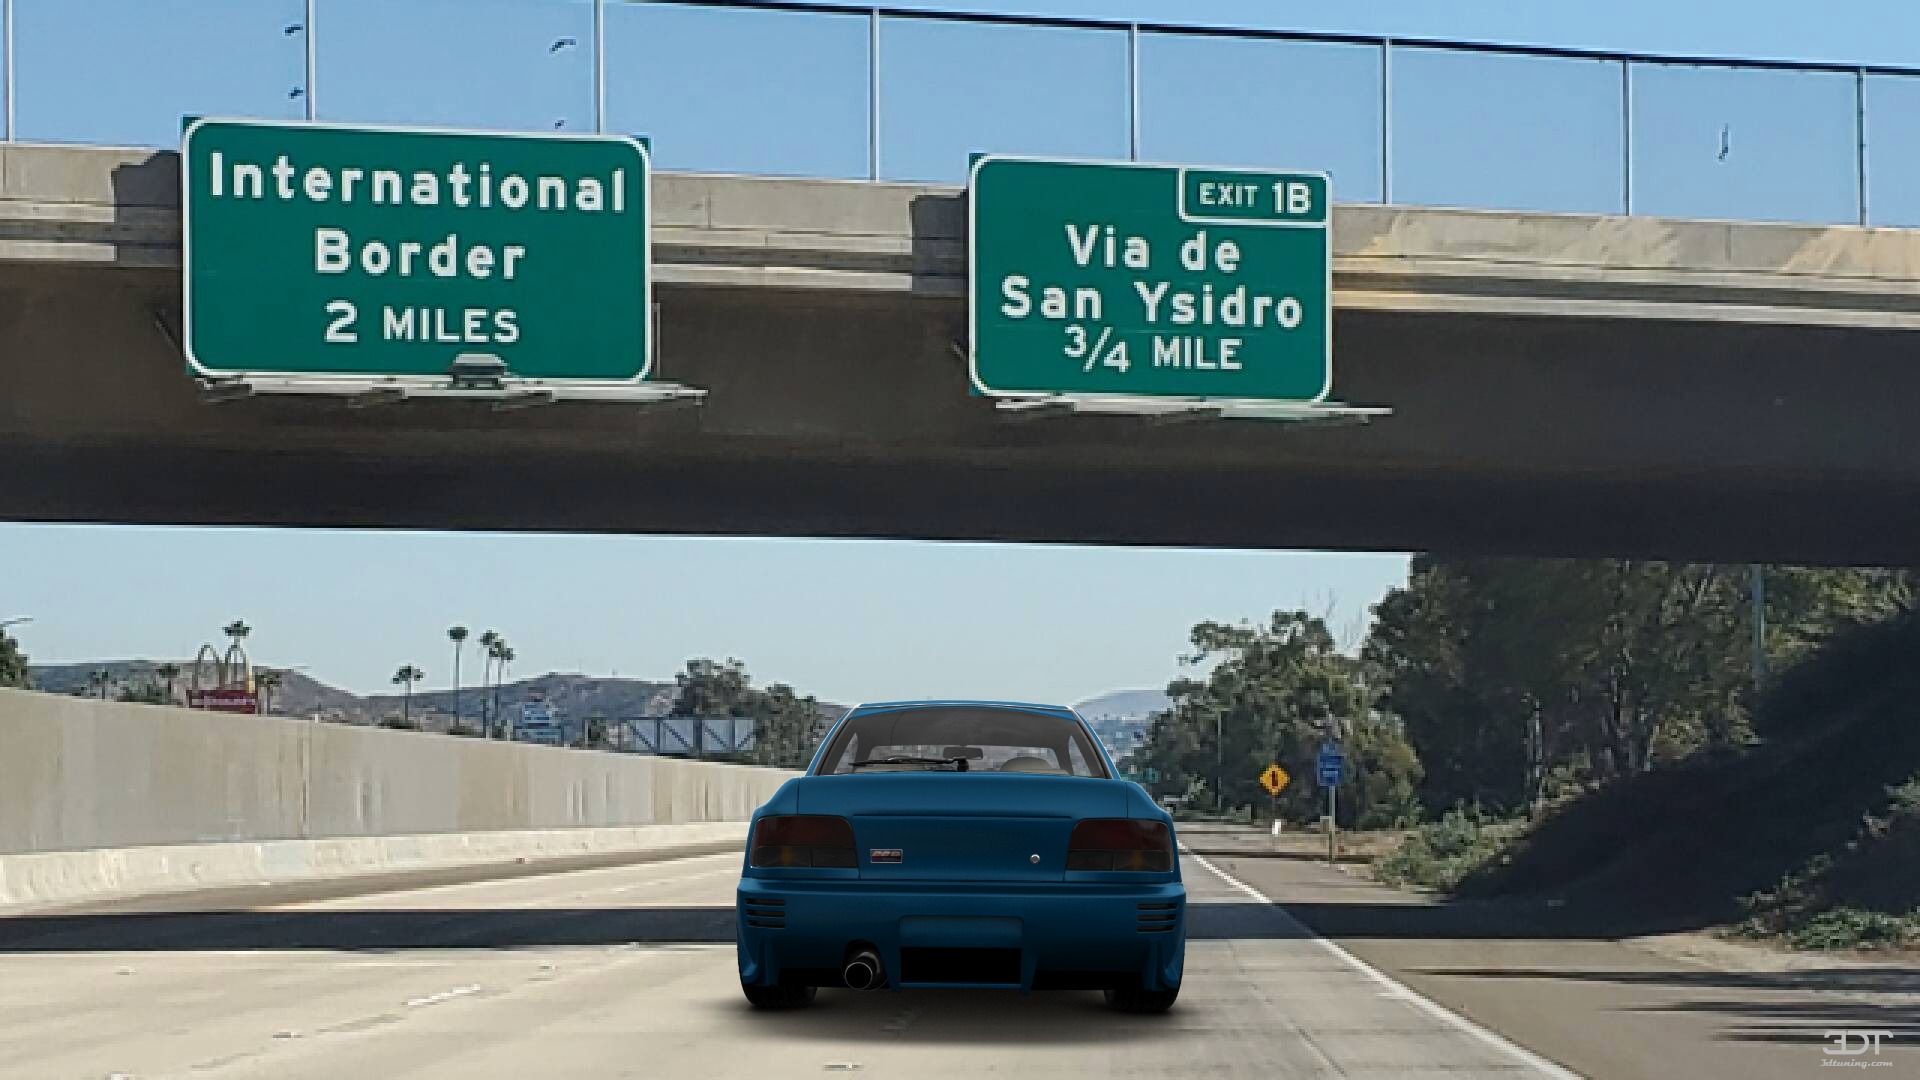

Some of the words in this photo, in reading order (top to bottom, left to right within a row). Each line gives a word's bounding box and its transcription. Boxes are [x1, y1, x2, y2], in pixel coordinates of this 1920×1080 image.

[212, 153, 626, 211] International
[1199, 182, 1259, 206] EXIT
[1271, 181, 1312, 214] 1B
[317, 228, 526, 280] Border
[1065, 225, 1150, 268] Via
[1180, 231, 1240, 272] de
[325, 300, 358, 343] 2
[383, 306, 521, 343] MILES
[1001, 275, 1102, 319] San
[1134, 281, 1303, 328] Ysidro
[1152, 336, 1243, 370] MILE
